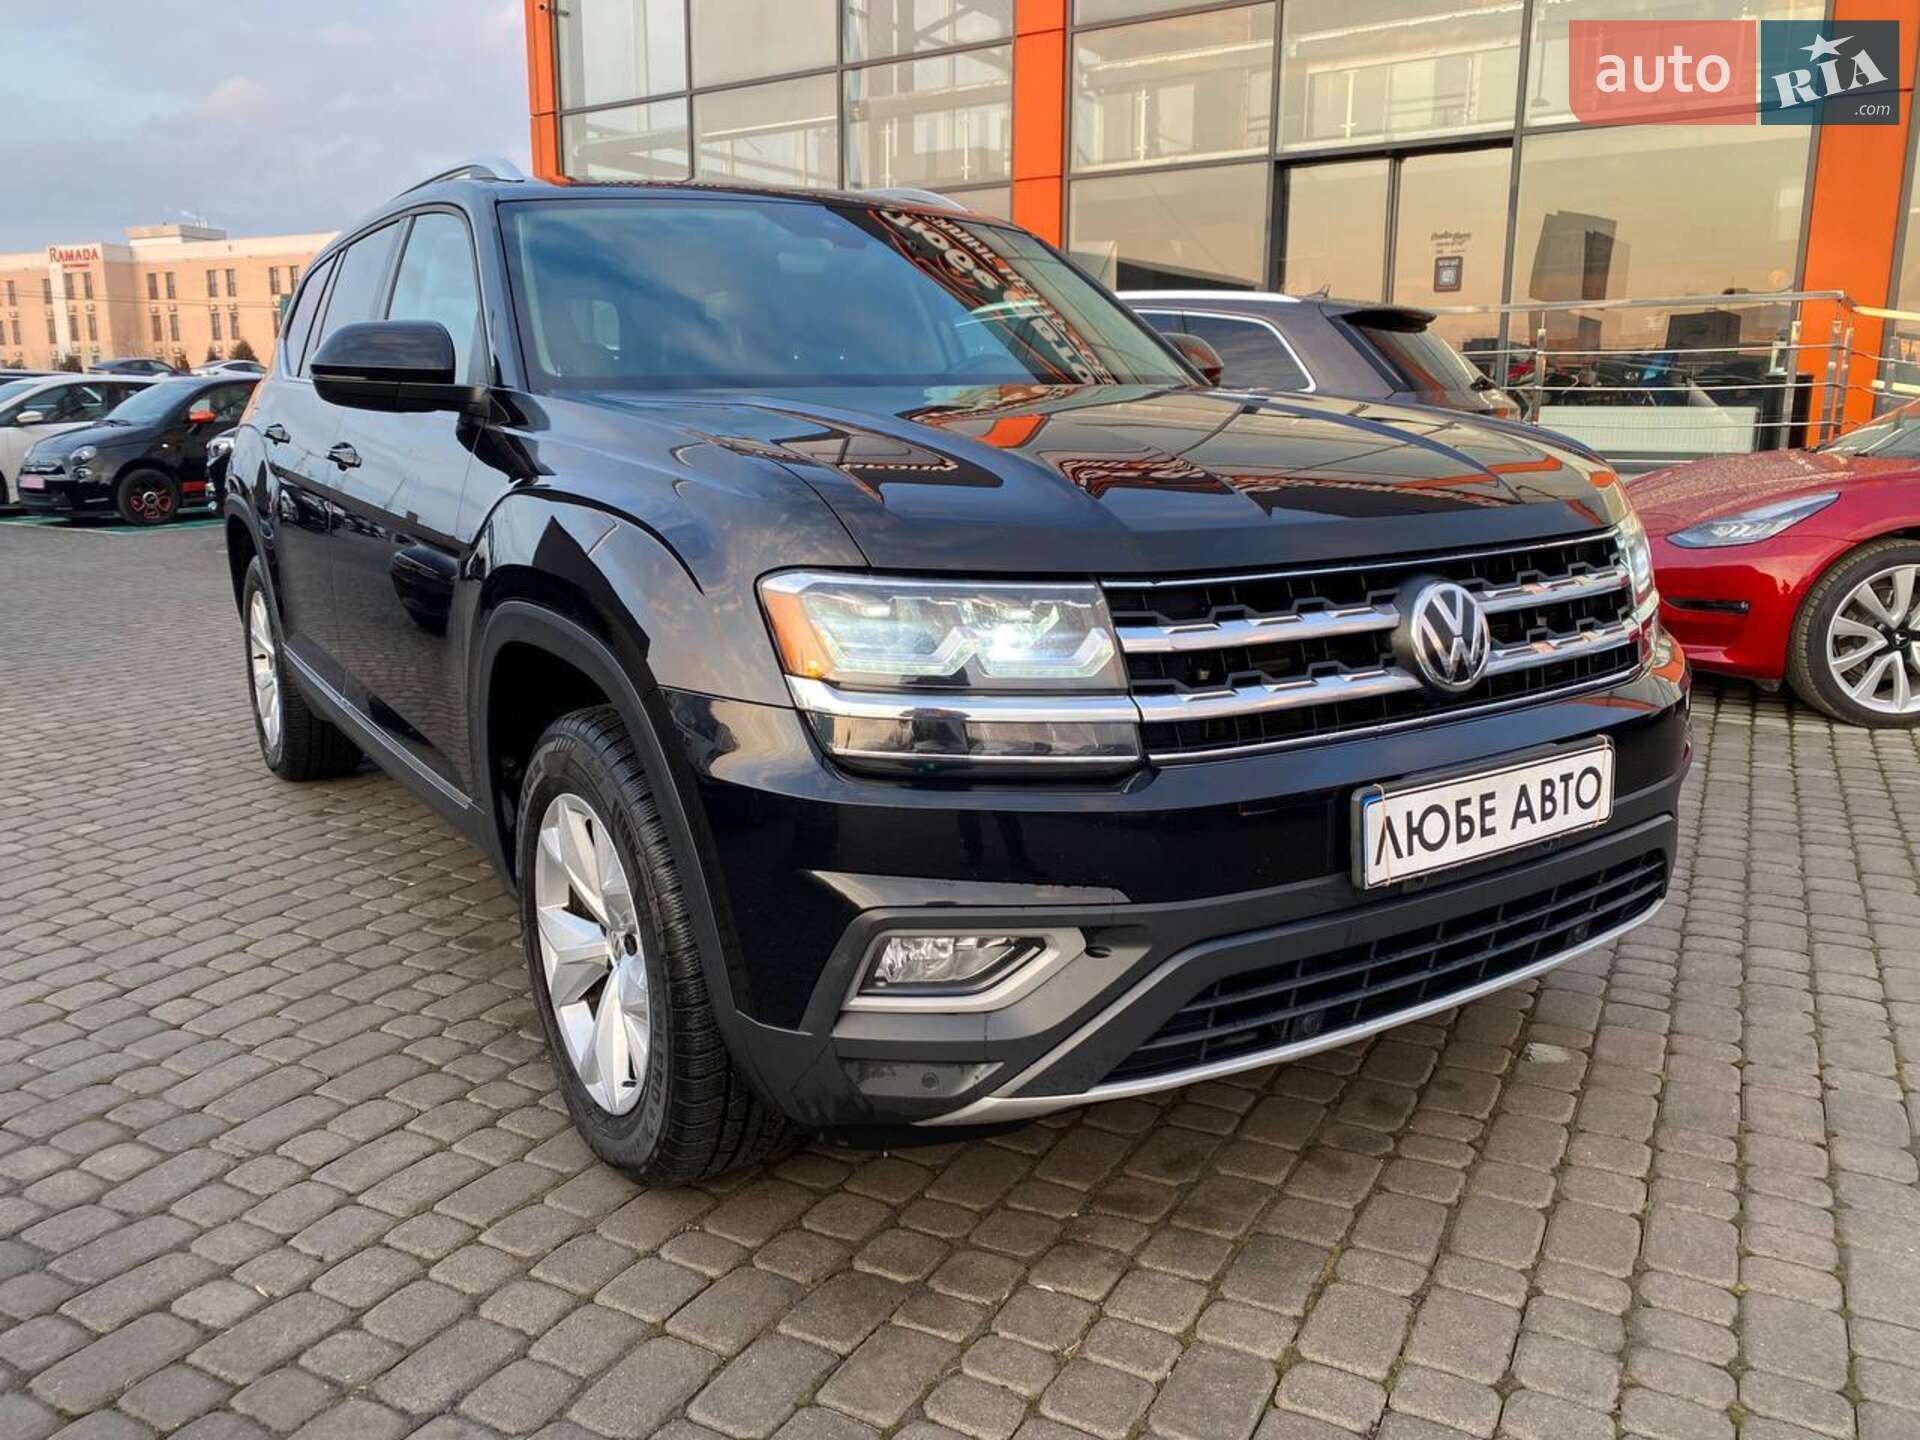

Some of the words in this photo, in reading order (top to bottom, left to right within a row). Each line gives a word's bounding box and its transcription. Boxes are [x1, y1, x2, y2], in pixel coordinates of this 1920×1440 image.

[48, 246, 98, 263] RAMADA
[1374, 791, 1496, 866] ЛЮБЕ
[1509, 766, 1602, 830] АВТО
